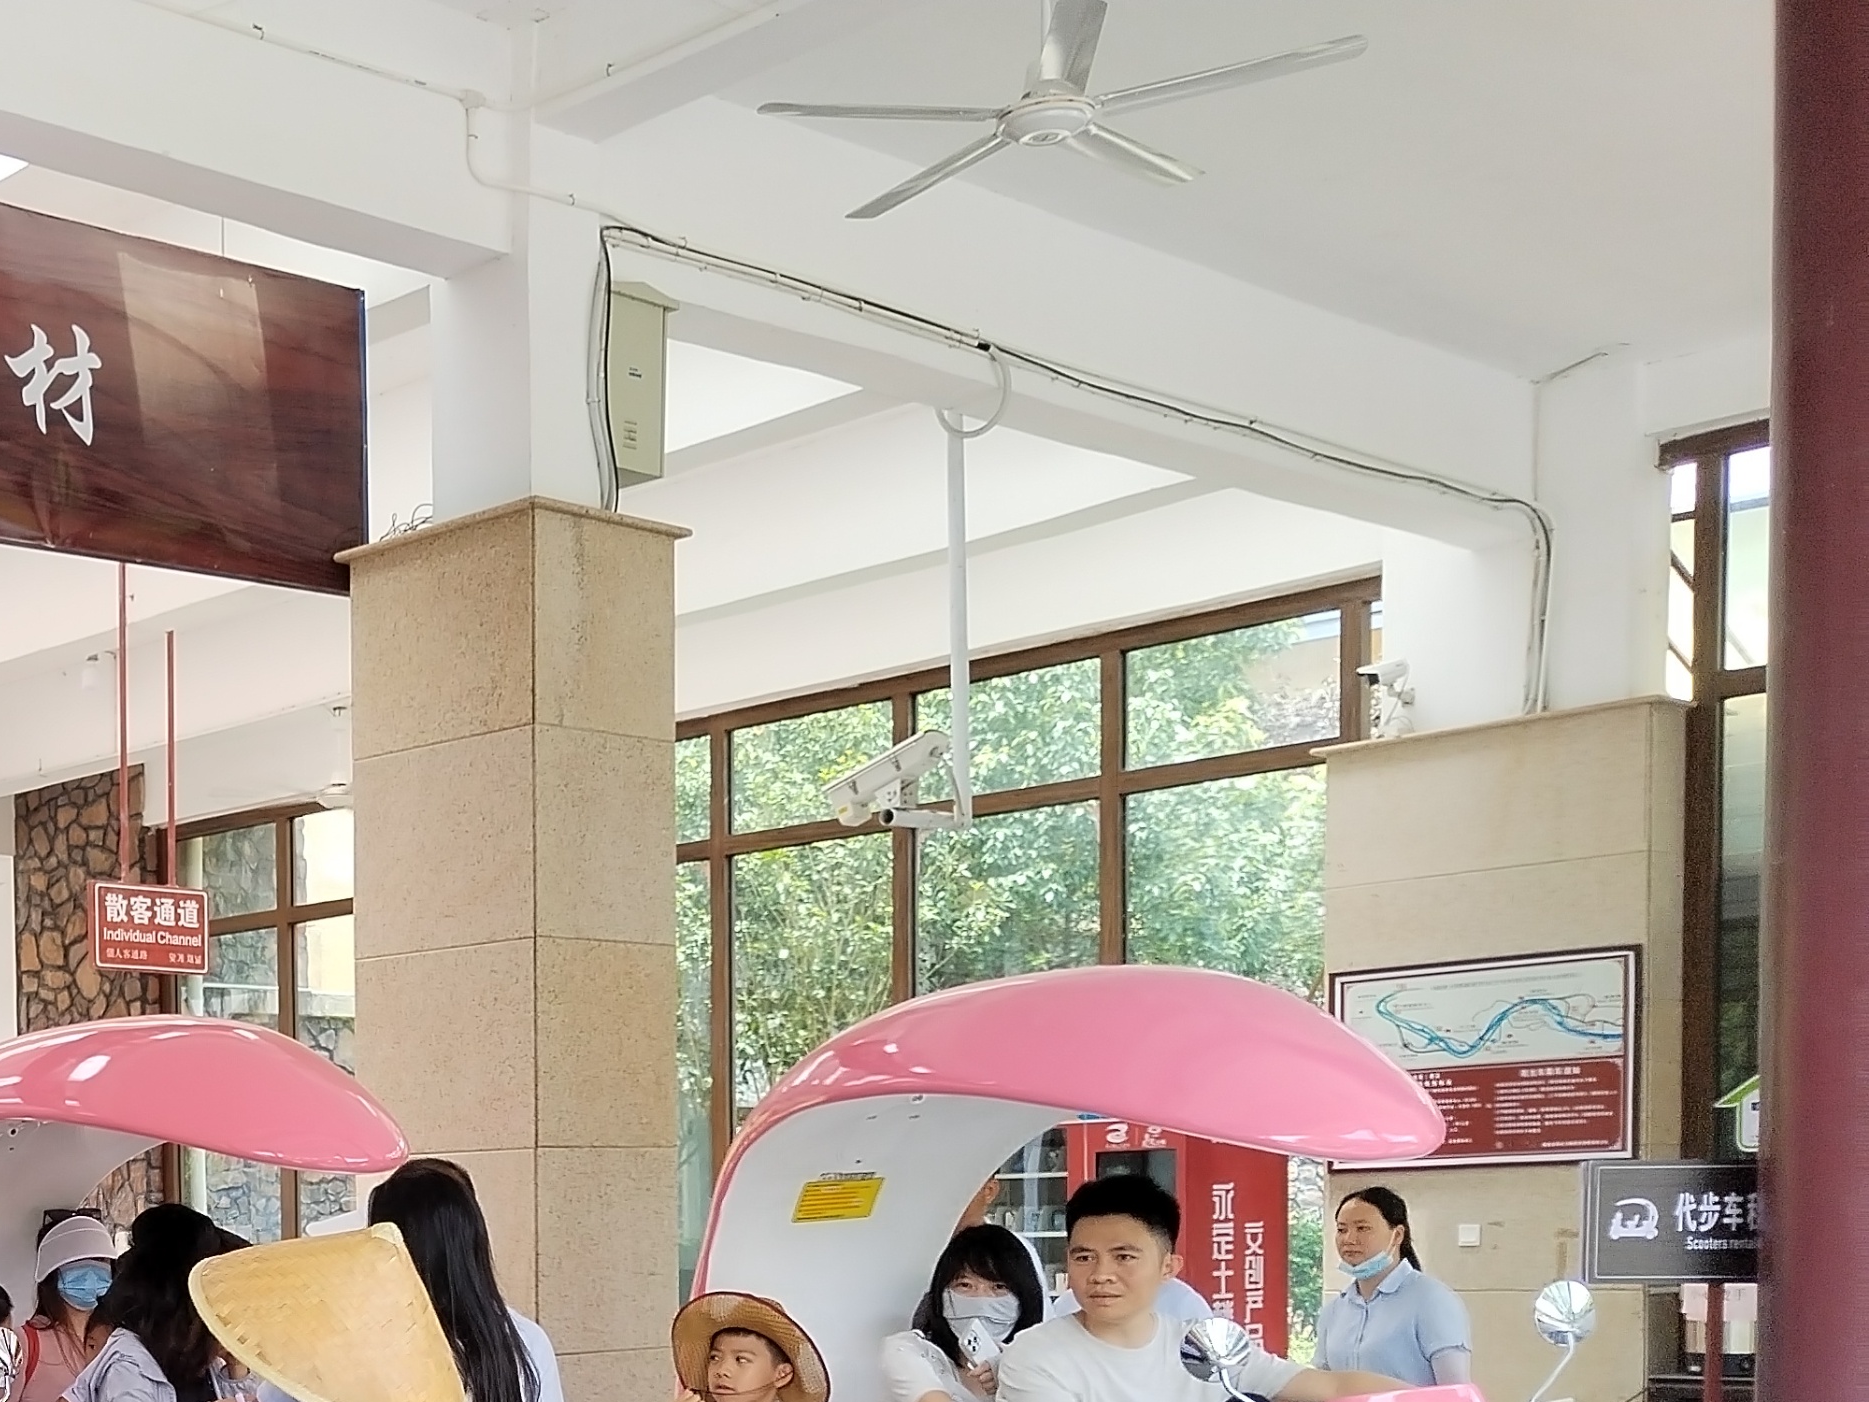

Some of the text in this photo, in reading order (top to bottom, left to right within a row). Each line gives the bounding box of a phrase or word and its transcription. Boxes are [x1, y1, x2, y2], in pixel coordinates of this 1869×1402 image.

[104, 892, 200, 928] 散客通道
[103, 926, 202, 947] Individual Channel
